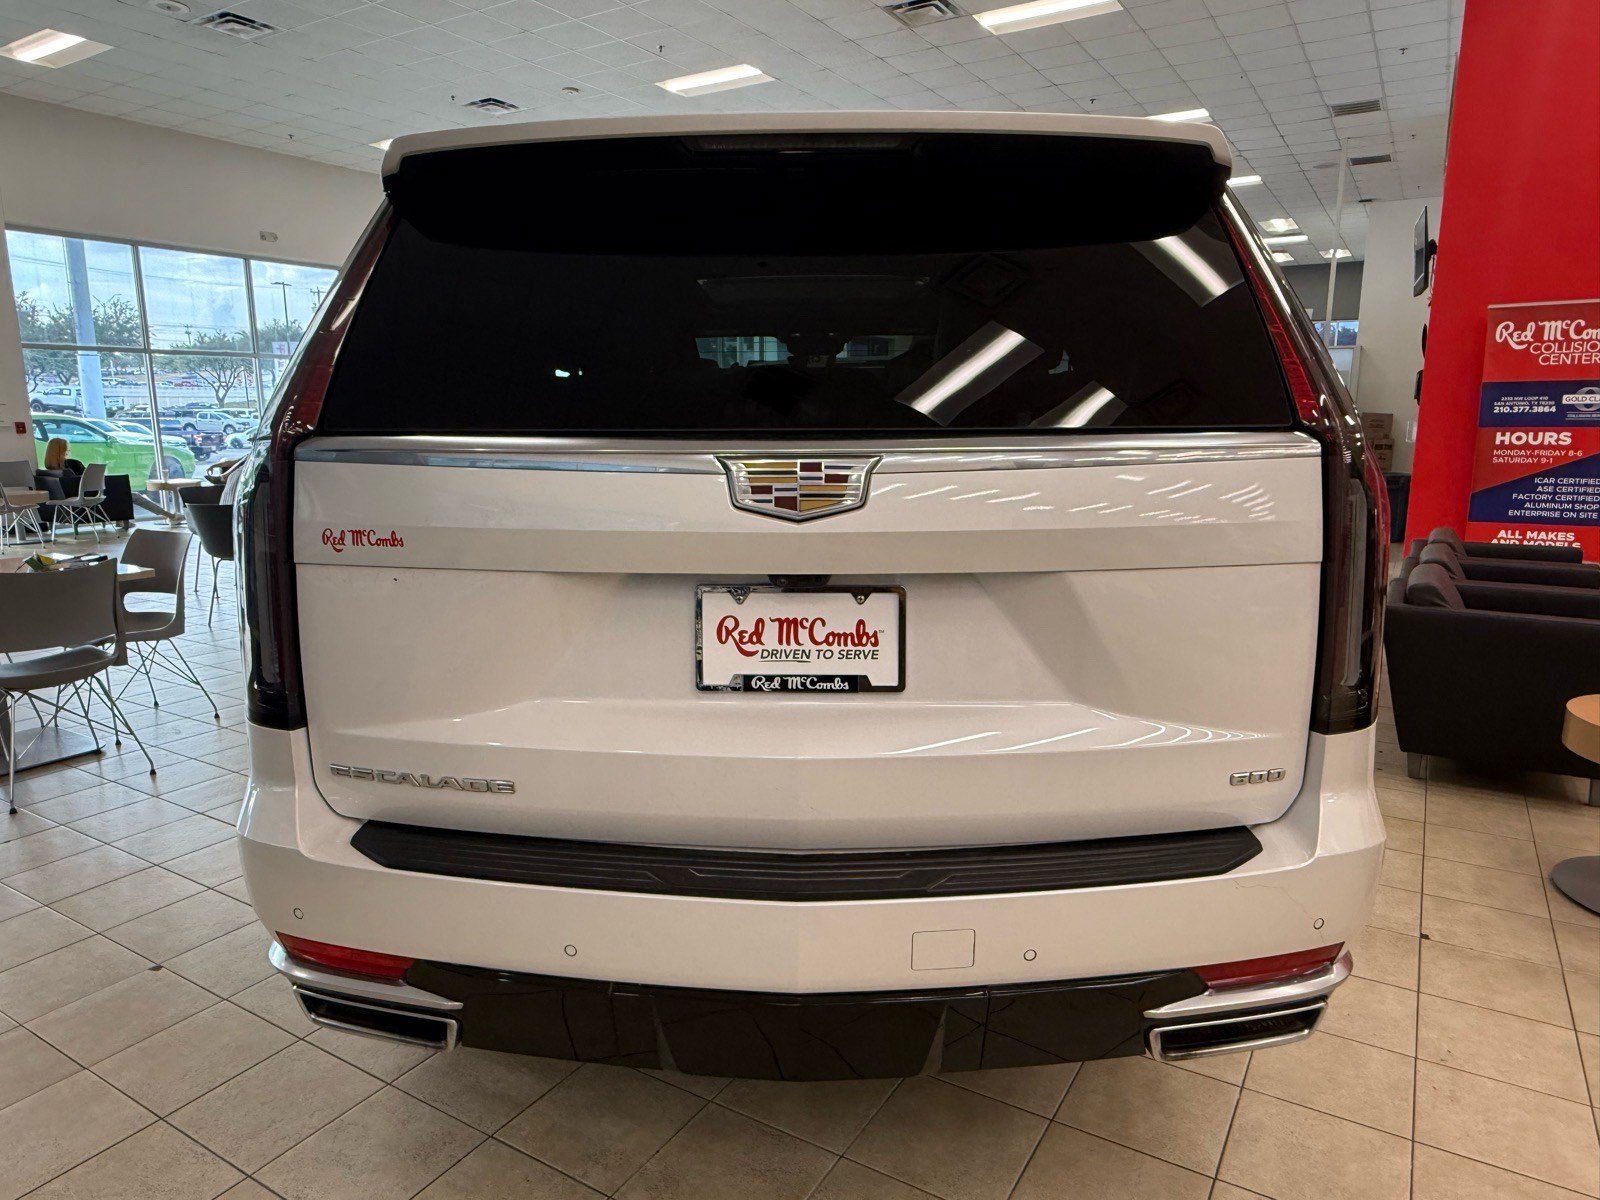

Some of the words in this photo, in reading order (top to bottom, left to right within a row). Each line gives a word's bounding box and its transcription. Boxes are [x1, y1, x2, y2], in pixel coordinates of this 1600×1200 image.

[1495, 321, 1535, 350] Red
[1538, 352, 1600, 365] CENTER
[1493, 405, 1556, 413] 210.377.3864
[1495, 431, 1572, 446] HOURS
[1493, 449, 1567, 457] MONDAY-FRIDAY
[1556, 486, 1600, 494] CERTIFIED
[1555, 494, 1600, 502] CERTIFIED
[322, 528, 346, 552] Red
[346, 529, 404, 547] McCombs
[1497, 529, 1522, 539] ALL
[1526, 531, 1576, 541] MAKES
[716, 615, 765, 657] Red
[769, 617, 879, 647] McCombs
[760, 649, 811, 660] DRIVEN
[815, 649, 834, 660] TO
[838, 649, 879, 660] SERVE
[751, 675, 780, 691] Red
[783, 675, 849, 690] McCombs
[329, 763, 516, 794] ESCALADE
[1230, 768, 1286, 786] 600
